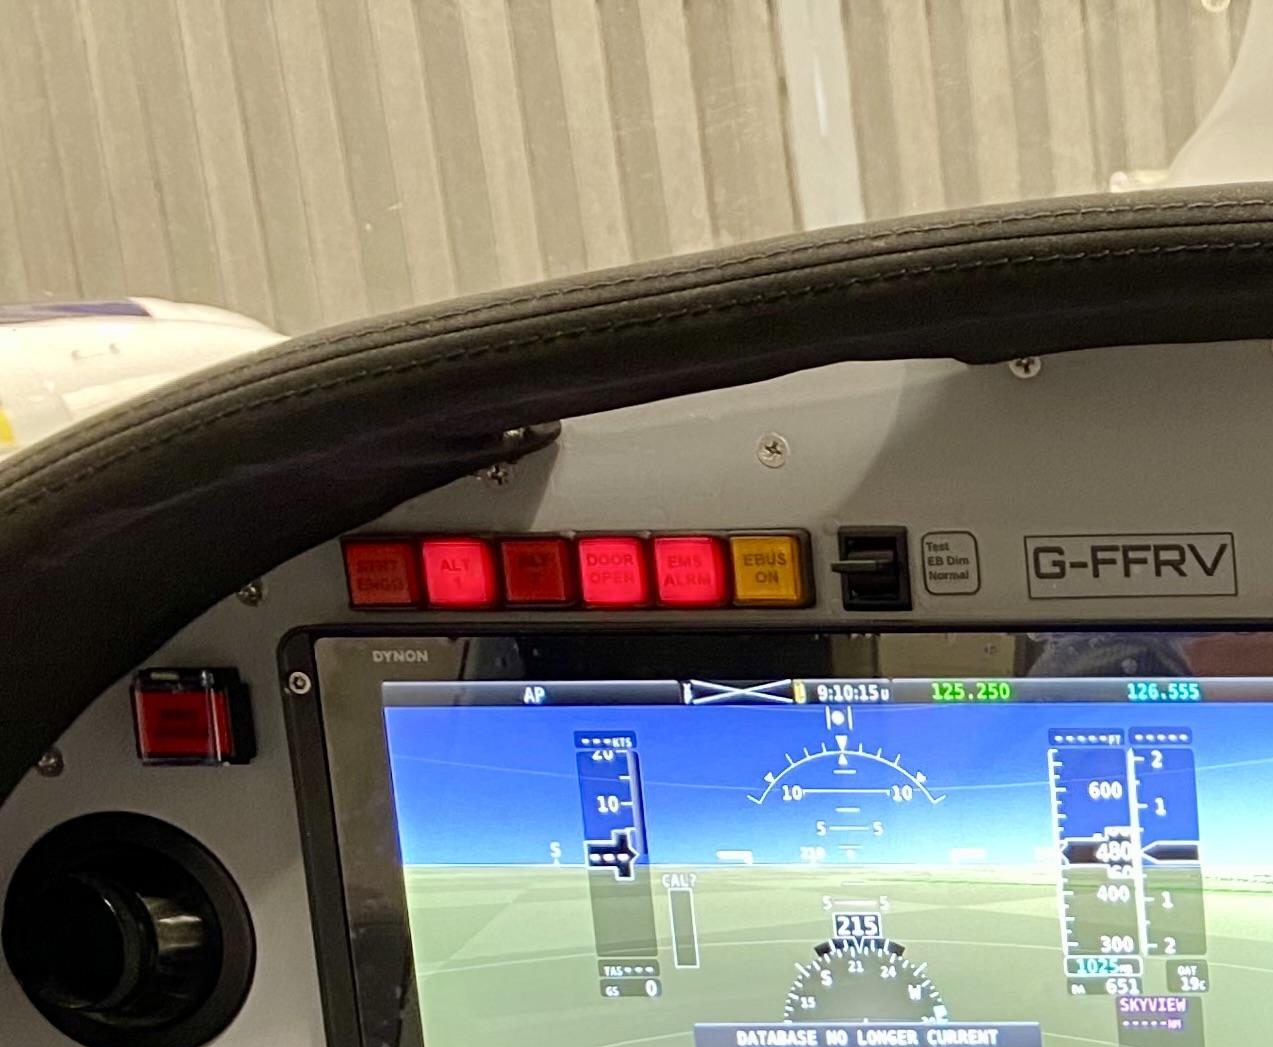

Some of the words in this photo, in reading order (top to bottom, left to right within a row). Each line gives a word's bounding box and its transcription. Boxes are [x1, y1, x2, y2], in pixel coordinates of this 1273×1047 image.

[441, 560, 469, 571] ALT
[586, 554, 633, 566] DOOR
[668, 556, 700, 568] EMS
[744, 554, 786, 566] EBUS
[928, 556, 944, 566] EB
[946, 556, 969, 565] Dim
[1033, 544, 1227, 579] G-FFRV
[589, 573, 634, 584] OPEN
[664, 574, 710, 587] ALRM
[755, 572, 778, 583] ON
[929, 570, 969, 580] Normal
[373, 651, 428, 662] DYNON
[524, 686, 545, 703] AP
[931, 682, 1010, 699] 125.250
[1128, 683, 1199, 700] 126.555
[1089, 781, 1122, 799] 600
[837, 917, 878, 935] 215
[1120, 998, 1187, 1012] SKYVIEW
[736, 1030, 817, 1046] DATABASE
[826, 1031, 848, 1045] NO
[857, 1030, 918, 1044] LONGER
[927, 1030, 998, 1044] CURRENT
